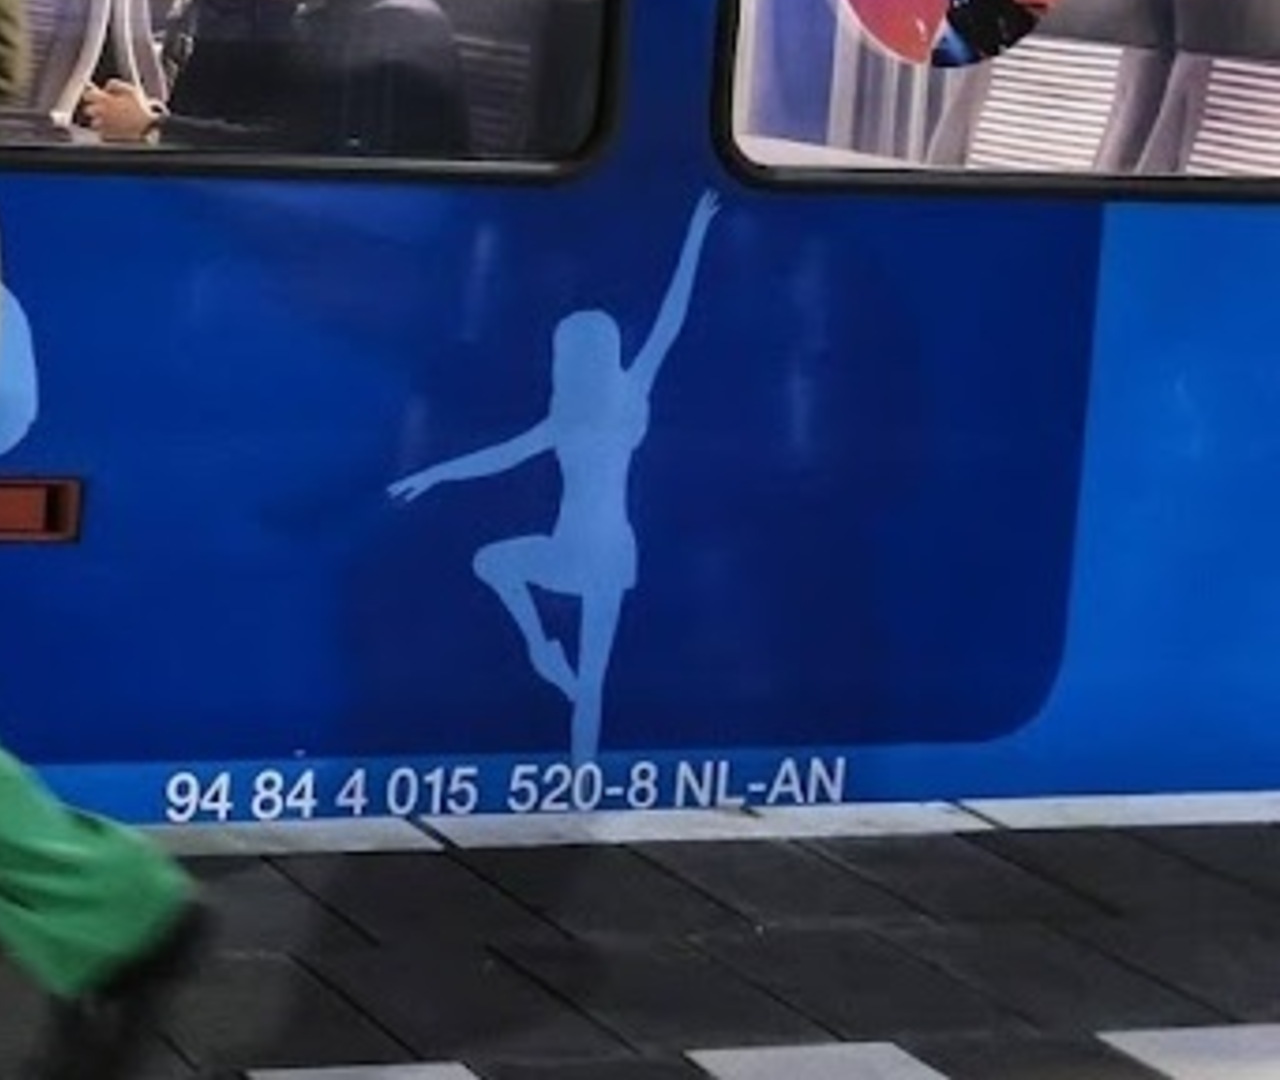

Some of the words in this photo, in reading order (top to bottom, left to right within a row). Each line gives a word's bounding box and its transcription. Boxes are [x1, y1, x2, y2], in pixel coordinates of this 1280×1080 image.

[165, 771, 233, 821] 94
[251, 769, 317, 819] 84
[335, 768, 368, 816] 4
[386, 765, 479, 815] 015
[507, 760, 659, 813] 520-8
[674, 756, 847, 809] NL-AN
